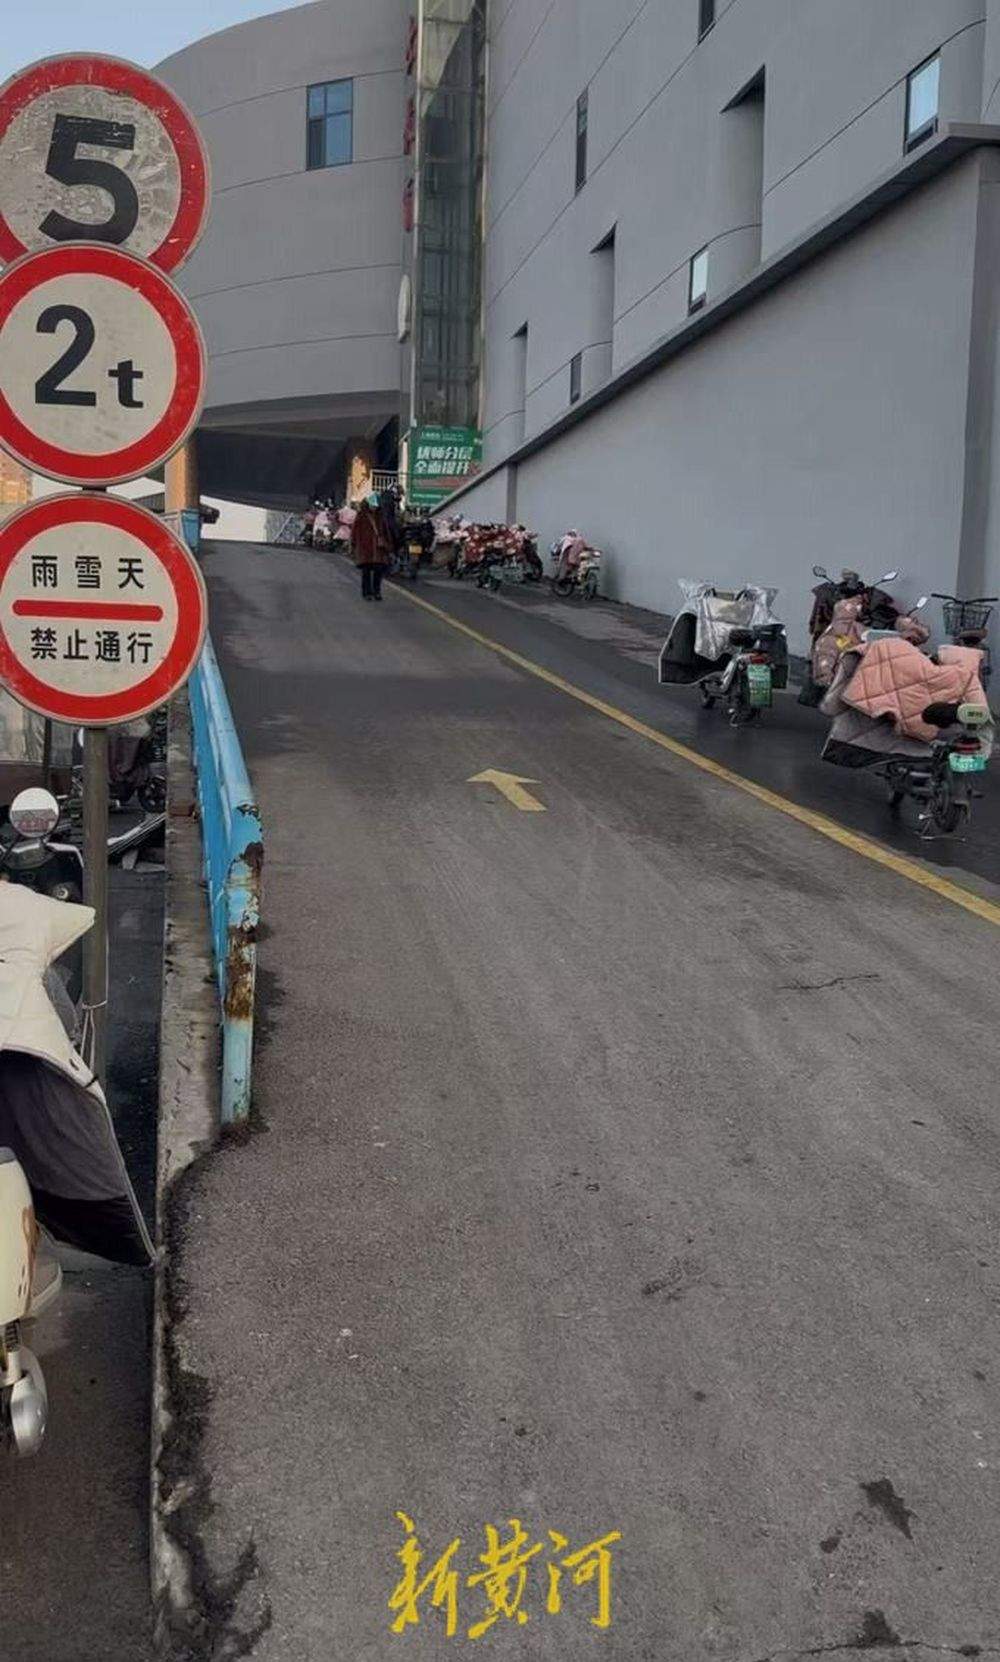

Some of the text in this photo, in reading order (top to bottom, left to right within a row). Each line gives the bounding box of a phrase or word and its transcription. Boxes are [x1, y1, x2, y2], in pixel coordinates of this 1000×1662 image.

[38, 112, 139, 245] 5
[31, 555, 144, 589] 雨雪天
[31, 627, 153, 664] 禁止通行
